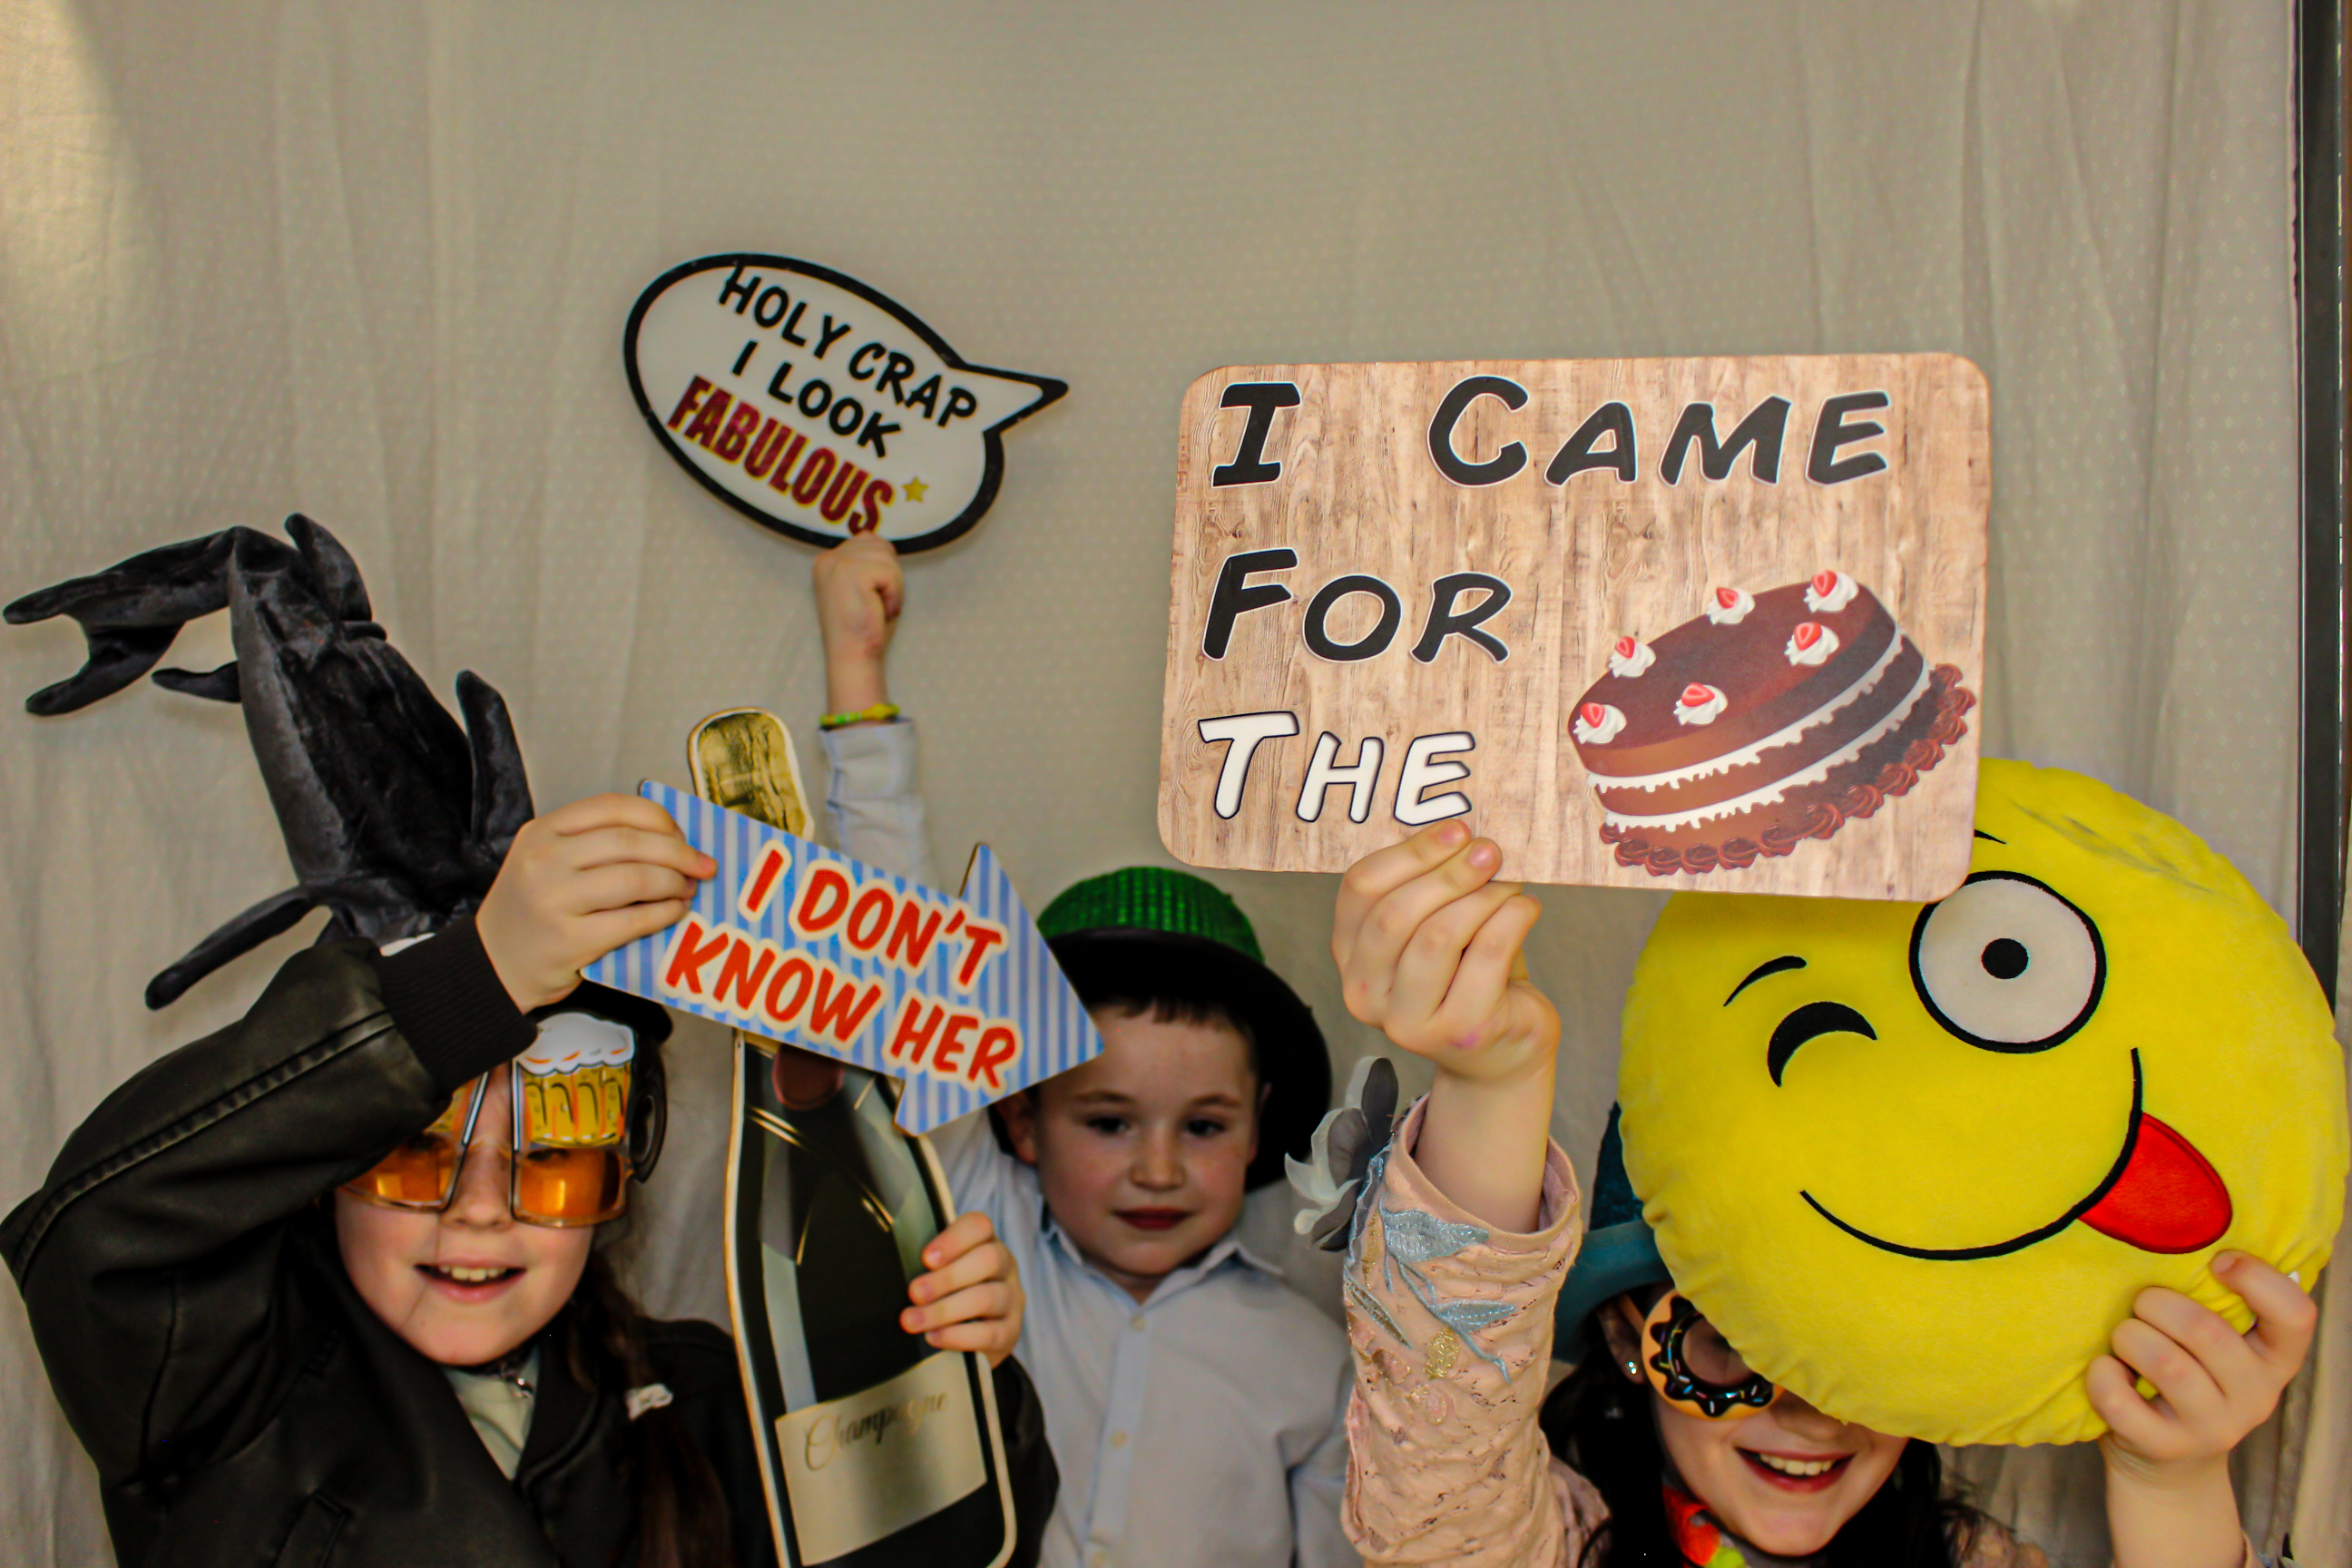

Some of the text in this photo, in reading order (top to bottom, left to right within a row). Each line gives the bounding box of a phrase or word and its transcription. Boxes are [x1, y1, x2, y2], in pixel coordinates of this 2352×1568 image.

[718, 263, 978, 427] HOLY CRAP
[730, 339, 902, 458] I LOOK
[666, 374, 895, 535] FABULOUS
[1210, 374, 1890, 488] I CAME
[1201, 547, 1514, 665] FOR
[1197, 710, 1476, 828] THE
[746, 848, 1003, 988] I DON'T
[664, 919, 1016, 1091] KNOW HER
